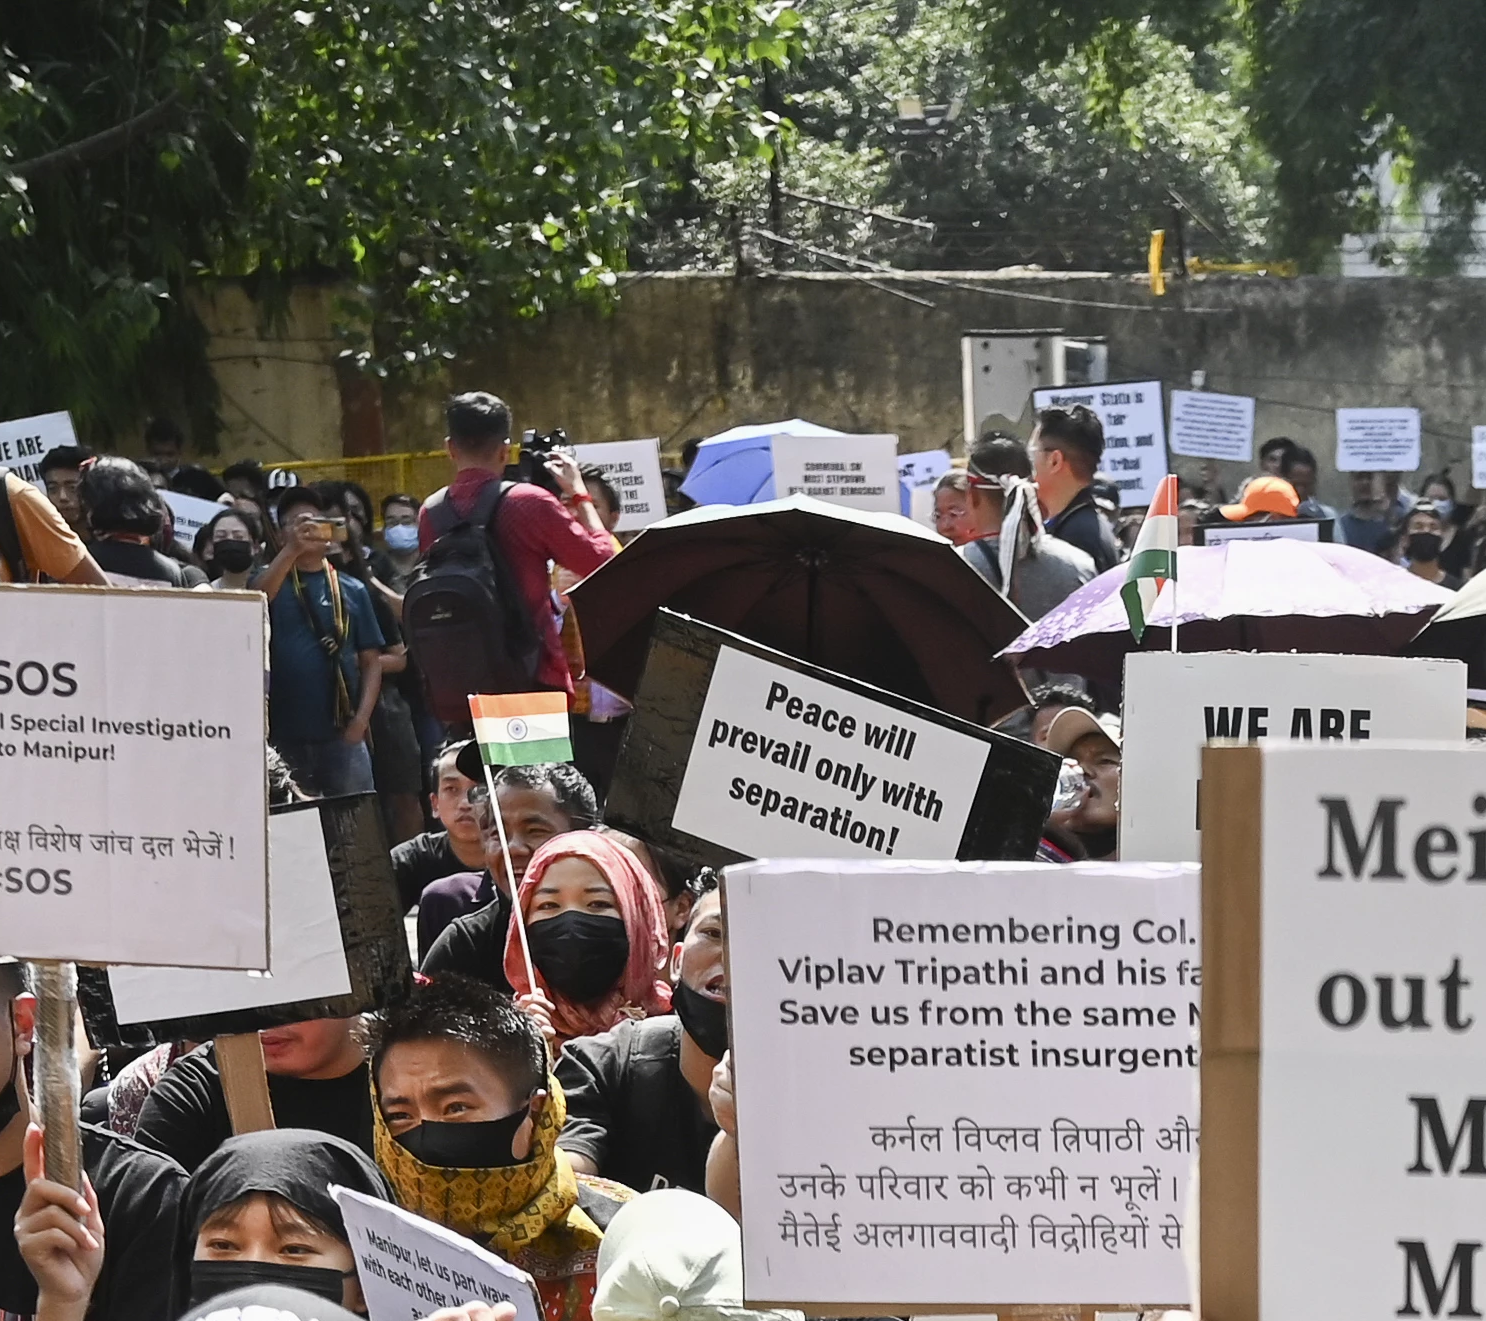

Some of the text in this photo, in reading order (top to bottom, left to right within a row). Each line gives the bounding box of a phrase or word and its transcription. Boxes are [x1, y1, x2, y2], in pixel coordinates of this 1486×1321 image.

[16, 436, 45, 456] ARE
[10, 713, 85, 736] Special
[91, 717, 231, 741] Investigation
[765, 680, 917, 761] Peace will
[23, 740, 115, 763] Manipur!
[707, 718, 943, 823] prevail only with
[728, 772, 907, 856] separation!
[27, 823, 84, 853] विशेष
[88, 830, 135, 855] जांच
[139, 836, 175, 860] दल
[872, 916, 1196, 951] Remembering Col.
[777, 955, 886, 991] Viplav
[894, 956, 1028, 992] Tripathi
[1040, 958, 1105, 986] and
[1117, 957, 1167, 986] his
[779, 999, 1177, 1027] Save us from the same
[1317, 957, 1473, 1033] out
[849, 1039, 1200, 1073] separatist insurgent
[868, 1114, 944, 1153] कर्नल
[952, 1116, 1042, 1153] विप्लव
[776, 1163, 1100, 1202] उनके परिवार को कभी न
[777, 1209, 843, 1253] मैतेई
[853, 1214, 1019, 1254] अलगाववादी
[1158, 1213, 1184, 1250] से
[362, 1254, 414, 1292] with each
[366, 1228, 415, 1270] Manipur,
[415, 1250, 433, 1276] let
[435, 1264, 450, 1282] us
[453, 1270, 479, 1295] part
